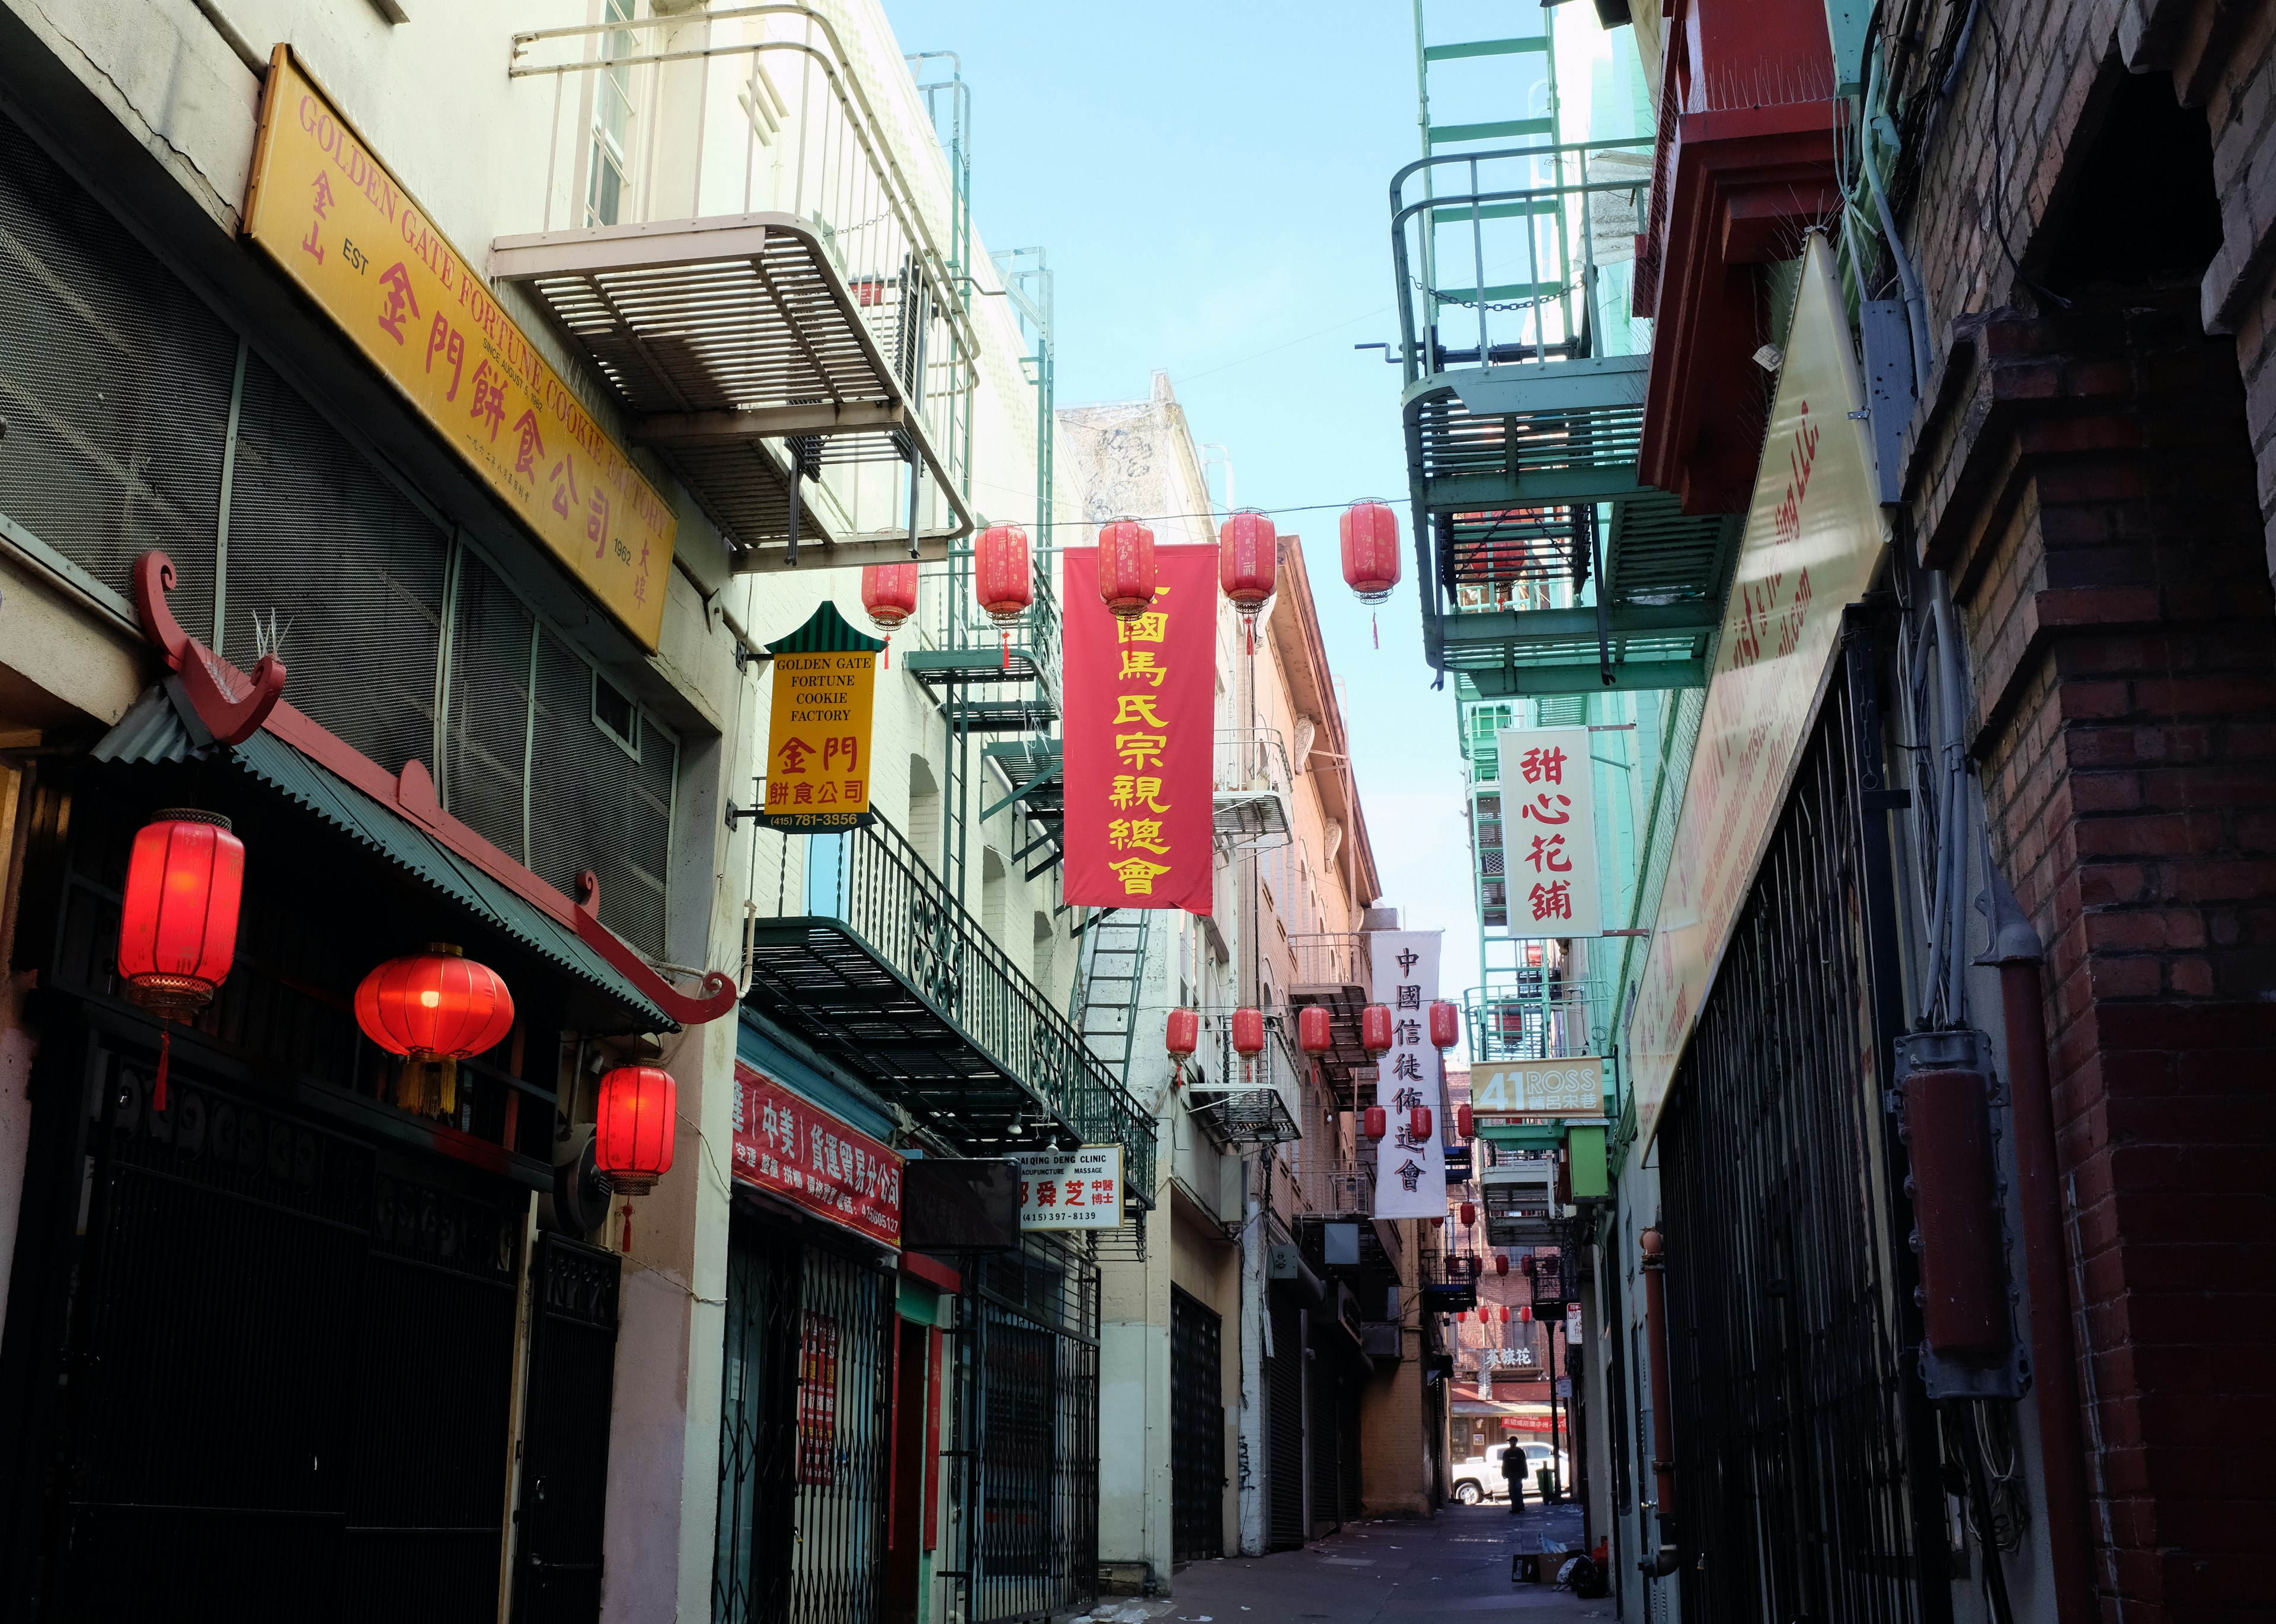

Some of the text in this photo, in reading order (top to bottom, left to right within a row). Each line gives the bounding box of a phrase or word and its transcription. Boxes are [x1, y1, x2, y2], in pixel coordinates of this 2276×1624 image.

[302, 170, 335, 266] 金山
[343, 237, 369, 276] EST
[299, 95, 670, 540] GOLDEN GATE FORTUNE COOKIE FACTORY
[482, 338, 501, 360] SINCE
[501, 361, 523, 388] AUGUST
[530, 395, 543, 413] 1962
[378, 261, 609, 560] 金門餅食公司
[614, 537, 631, 567] 1962
[634, 538, 649, 610] 大埠
[1756, 584, 1767, 637] &
[777, 658, 871, 671] GOLDEN GATE
[791, 675, 855, 688] FORTUNE
[791, 710, 851, 722] FACTORY
[797, 693, 847, 704] COOKIE
[777, 736, 858, 775] 金門
[768, 780, 864, 805] 餅食公司
[771, 814, 858, 827] (415) 781-3856
[1520, 746, 1572, 922] 甜心花舖
[1479, 1069, 1596, 1111] 41 ROSS
[1053, 1155, 1076, 1164] DENG
